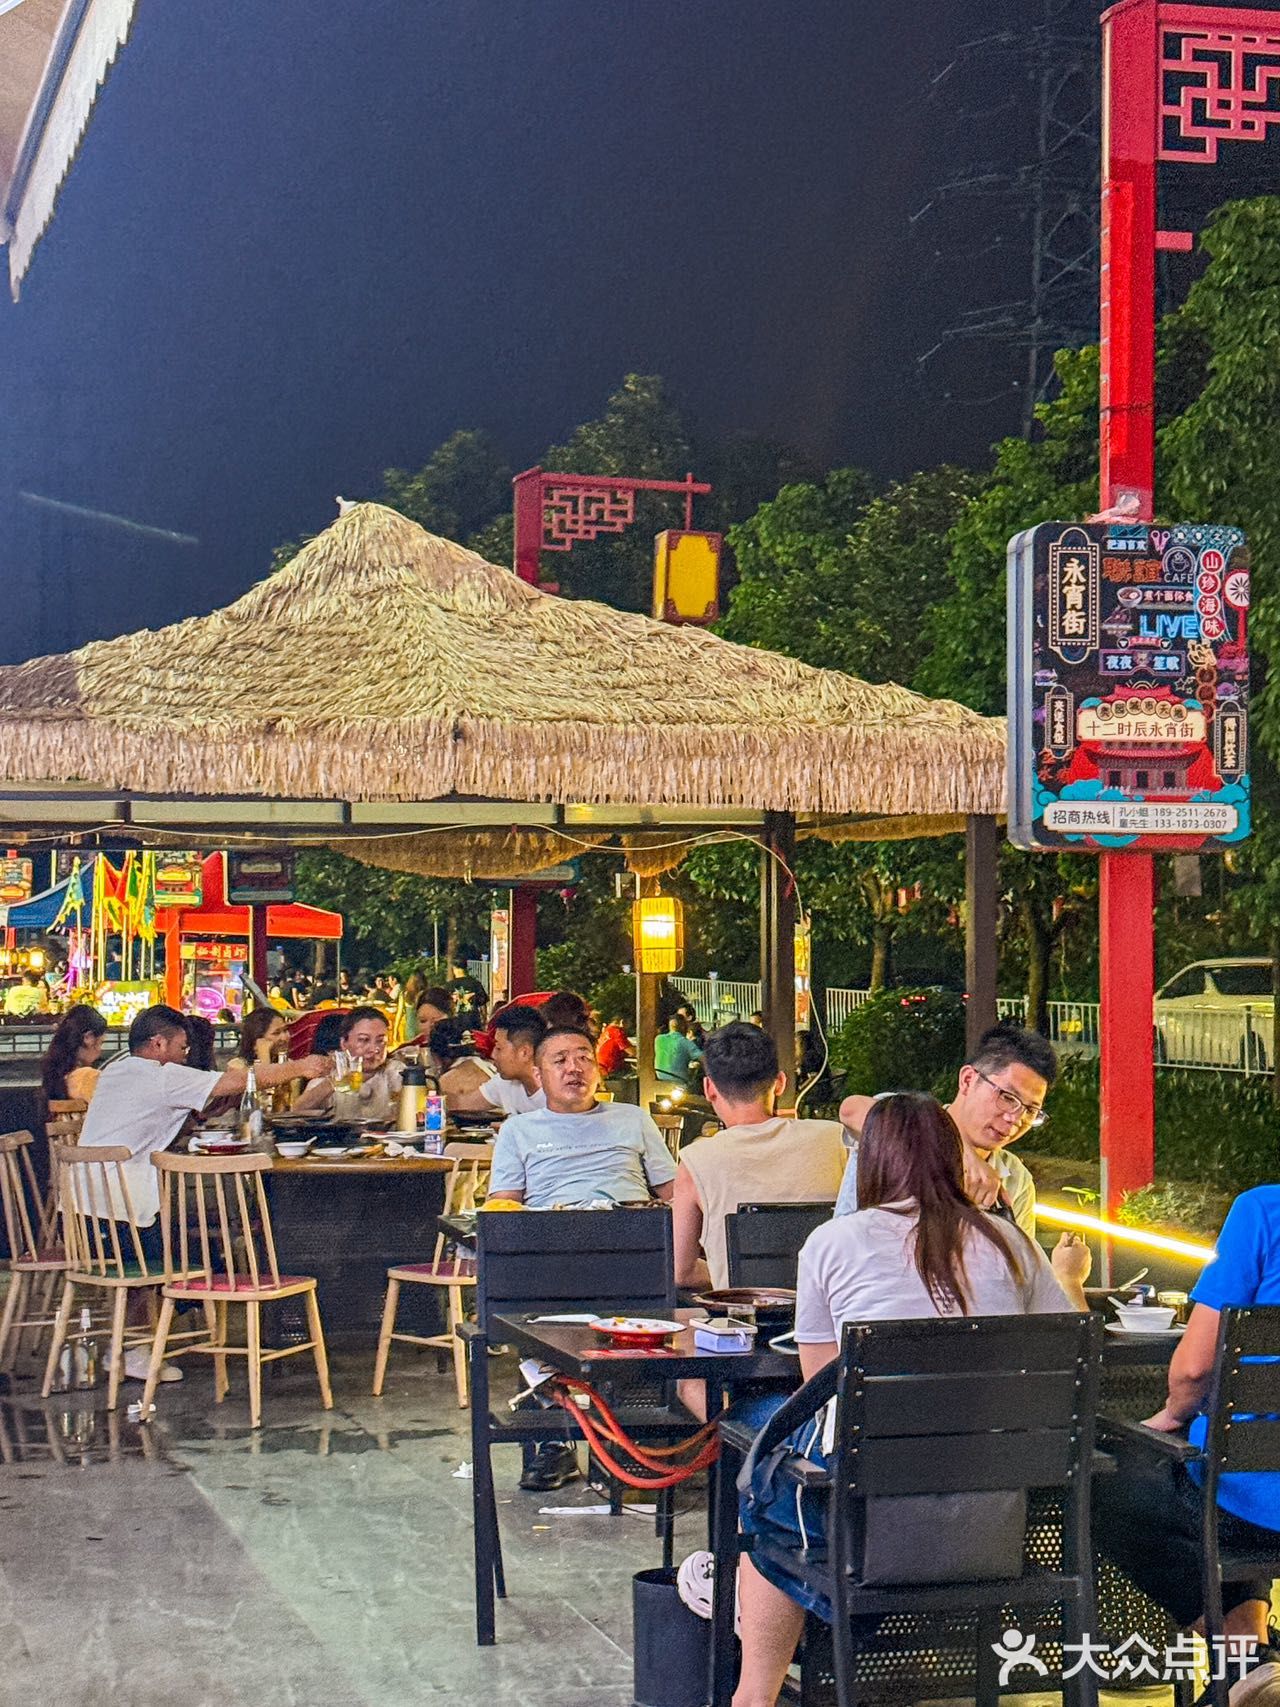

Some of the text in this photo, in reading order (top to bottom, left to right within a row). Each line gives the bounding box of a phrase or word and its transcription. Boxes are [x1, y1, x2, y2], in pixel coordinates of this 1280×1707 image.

[1164, 573, 1193, 583] CAFE
[1062, 557, 1087, 635] 永宵街
[1199, 552, 1222, 637] 山珍海味
[1139, 614, 1200, 639] LIVE
[1086, 720, 1195, 738] 十二时辰永宵街
[1052, 809, 1111, 825] 招商热线
[1119, 807, 1227, 818] 孔小姐 189-2511-2678
[1154, 818, 1227, 829] 133-1873-0307
